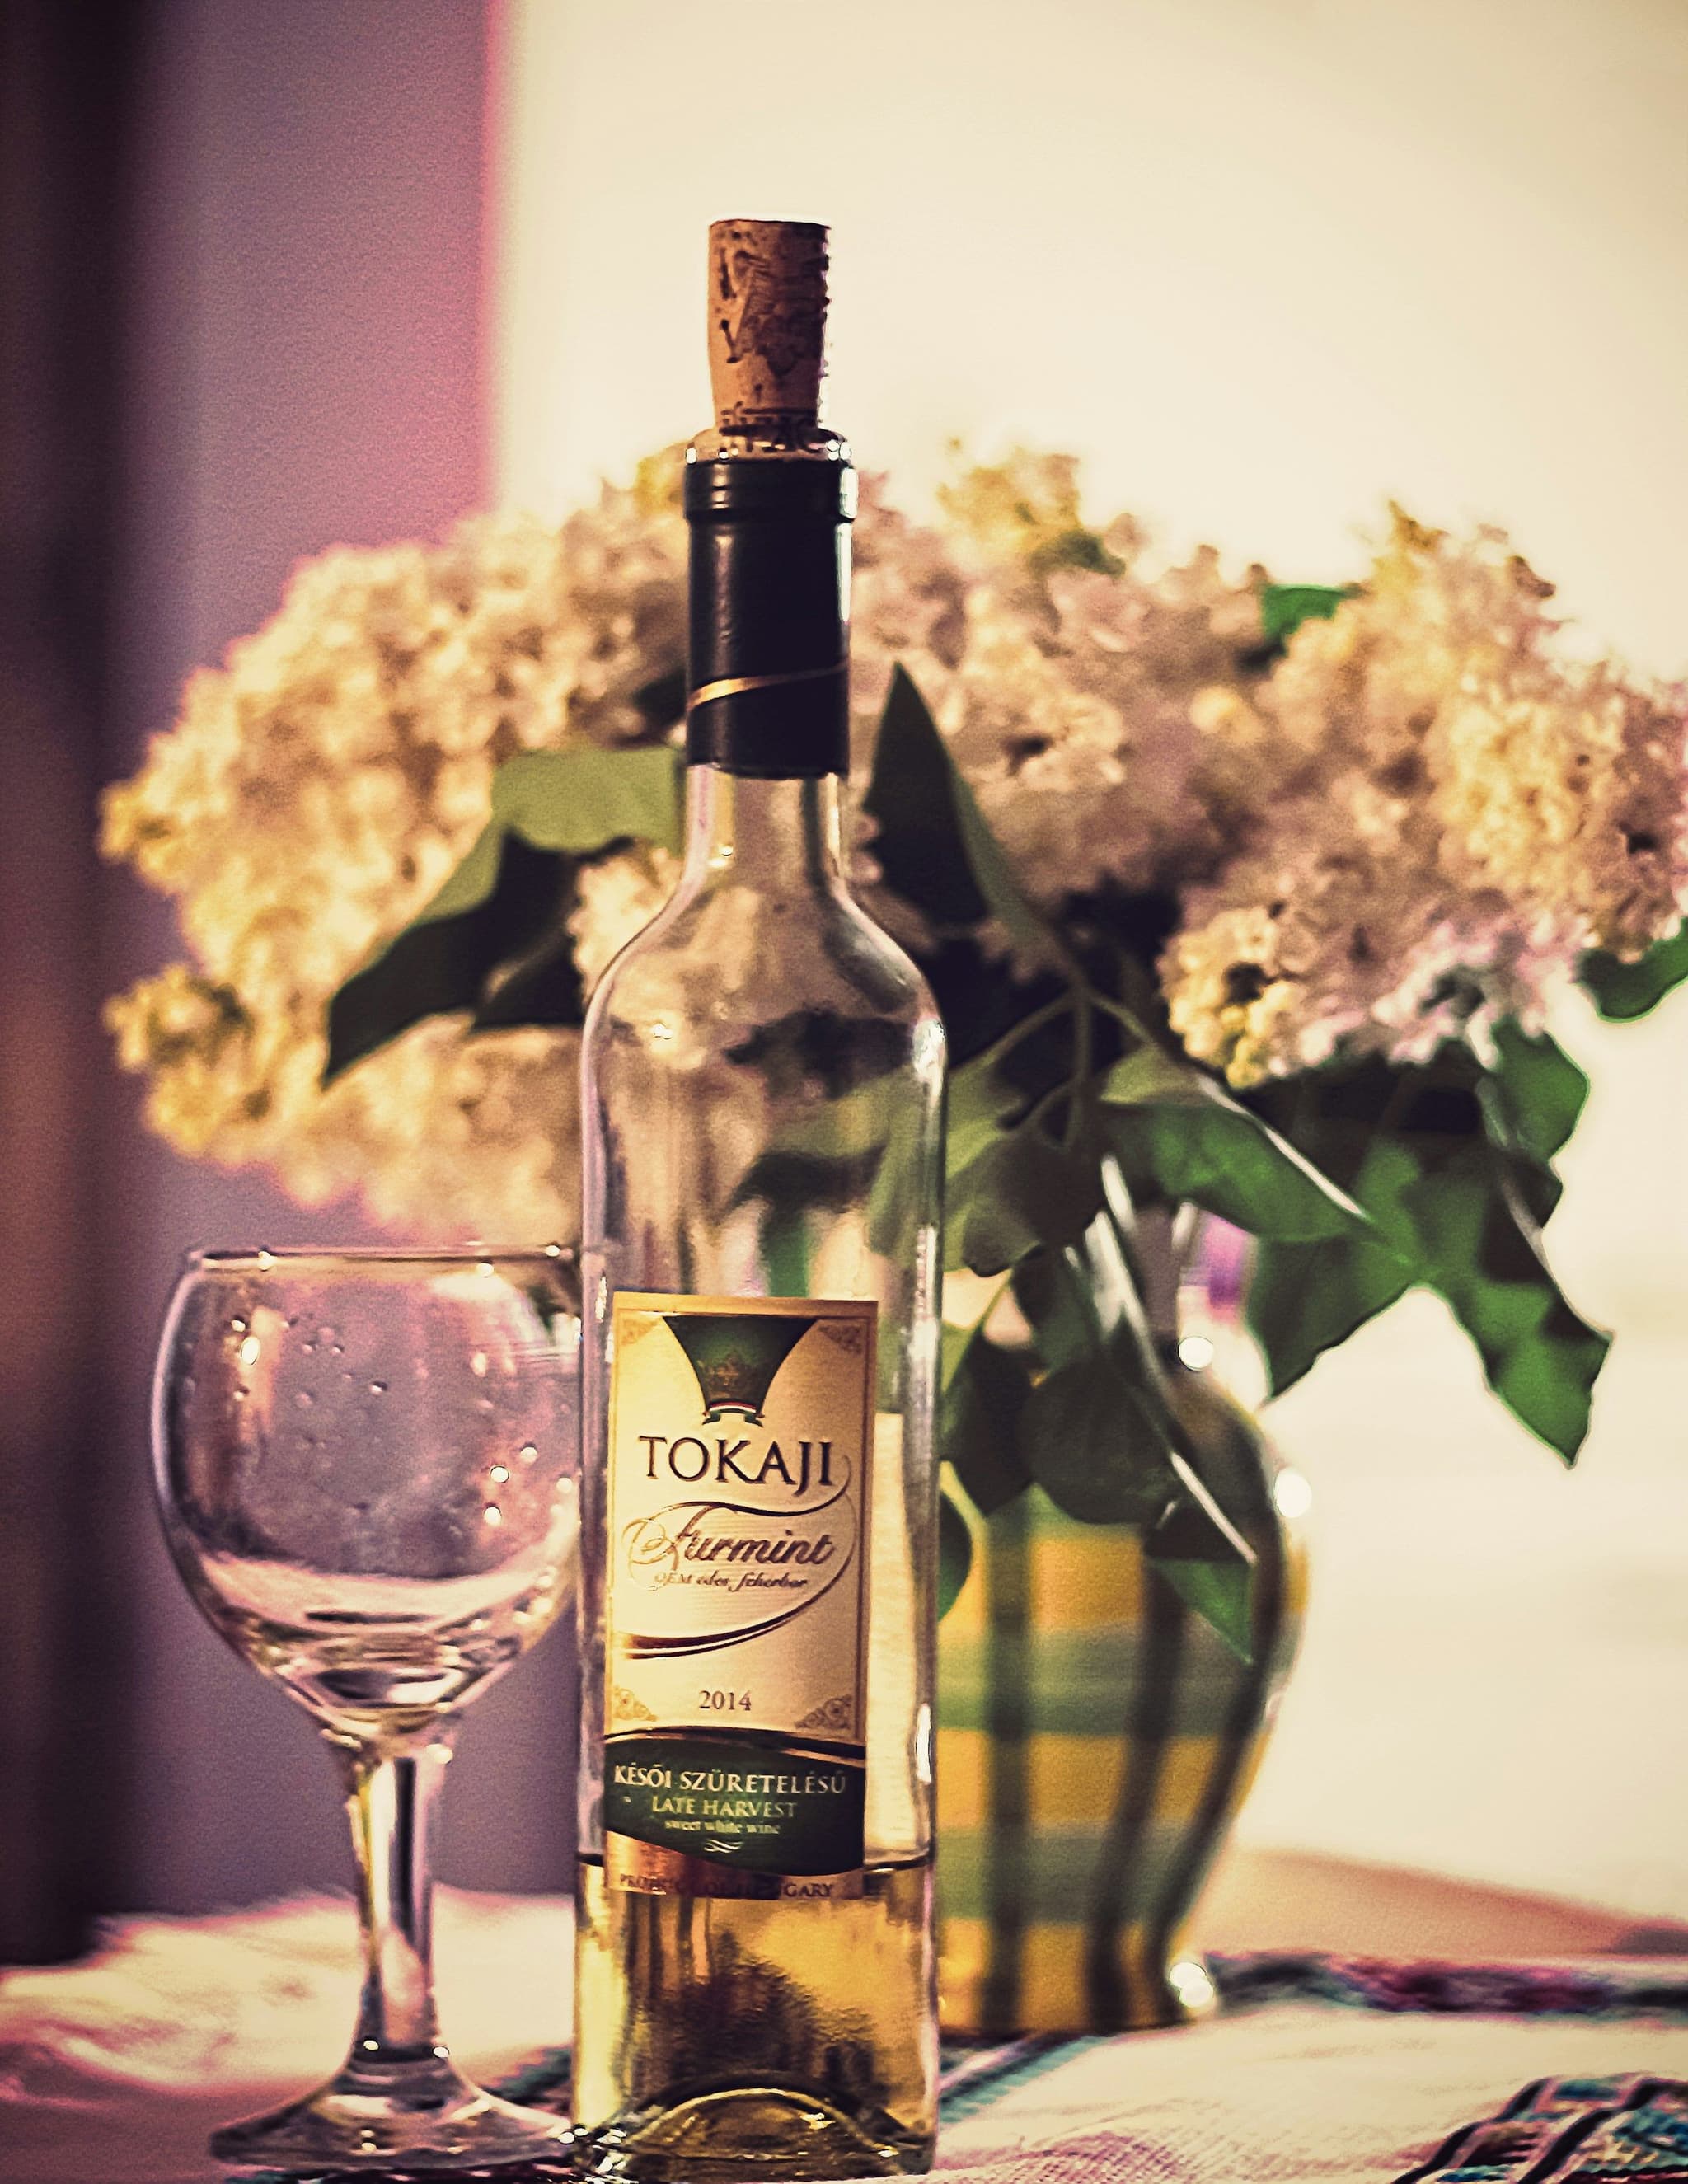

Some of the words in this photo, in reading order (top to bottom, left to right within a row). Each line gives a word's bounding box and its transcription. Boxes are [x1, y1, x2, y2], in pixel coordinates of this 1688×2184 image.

[639, 1436, 832, 1497] TOKAJI
[623, 1506, 836, 1572] Furmint
[699, 1690, 752, 1711] 2014
[652, 1796, 695, 1814] LATE
[702, 1799, 797, 1817] HARVEST
